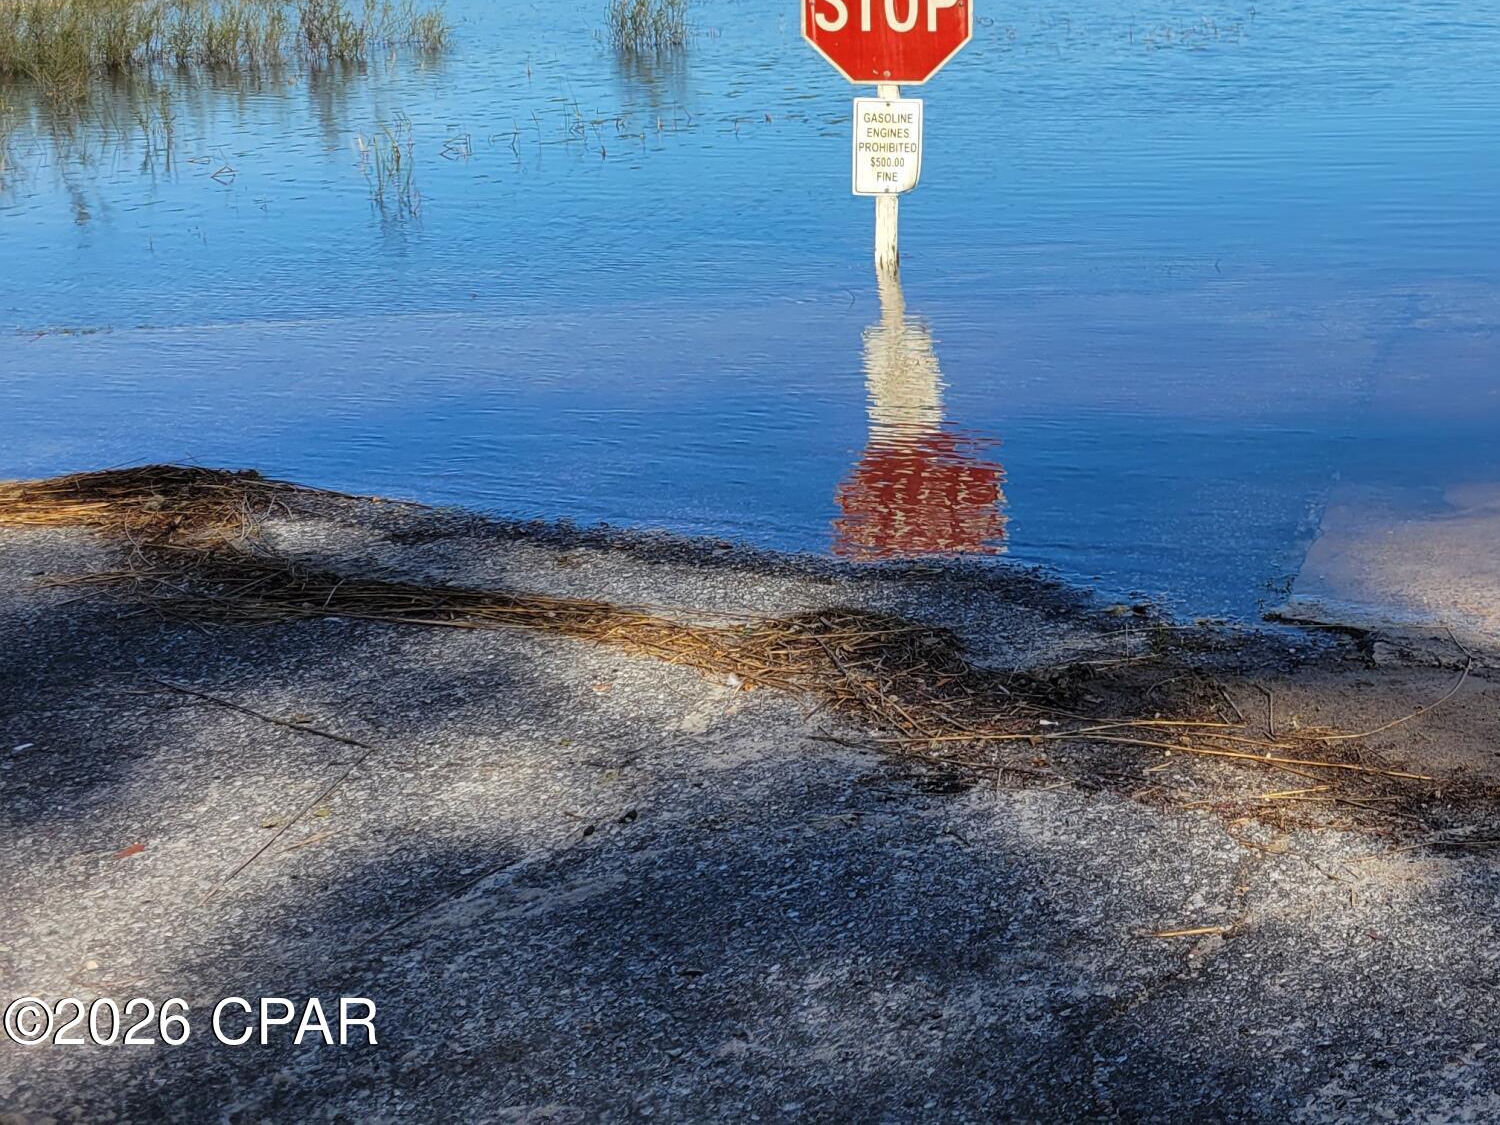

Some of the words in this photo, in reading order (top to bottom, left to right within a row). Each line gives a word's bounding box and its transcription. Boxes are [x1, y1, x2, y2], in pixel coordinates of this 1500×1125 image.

[863, 113, 913, 124] GASOLINE
[866, 127, 910, 139] ENGINES
[858, 142, 917, 153] PROHIBITED
[870, 156, 905, 167] $500.00
[876, 171, 899, 182] FINE
